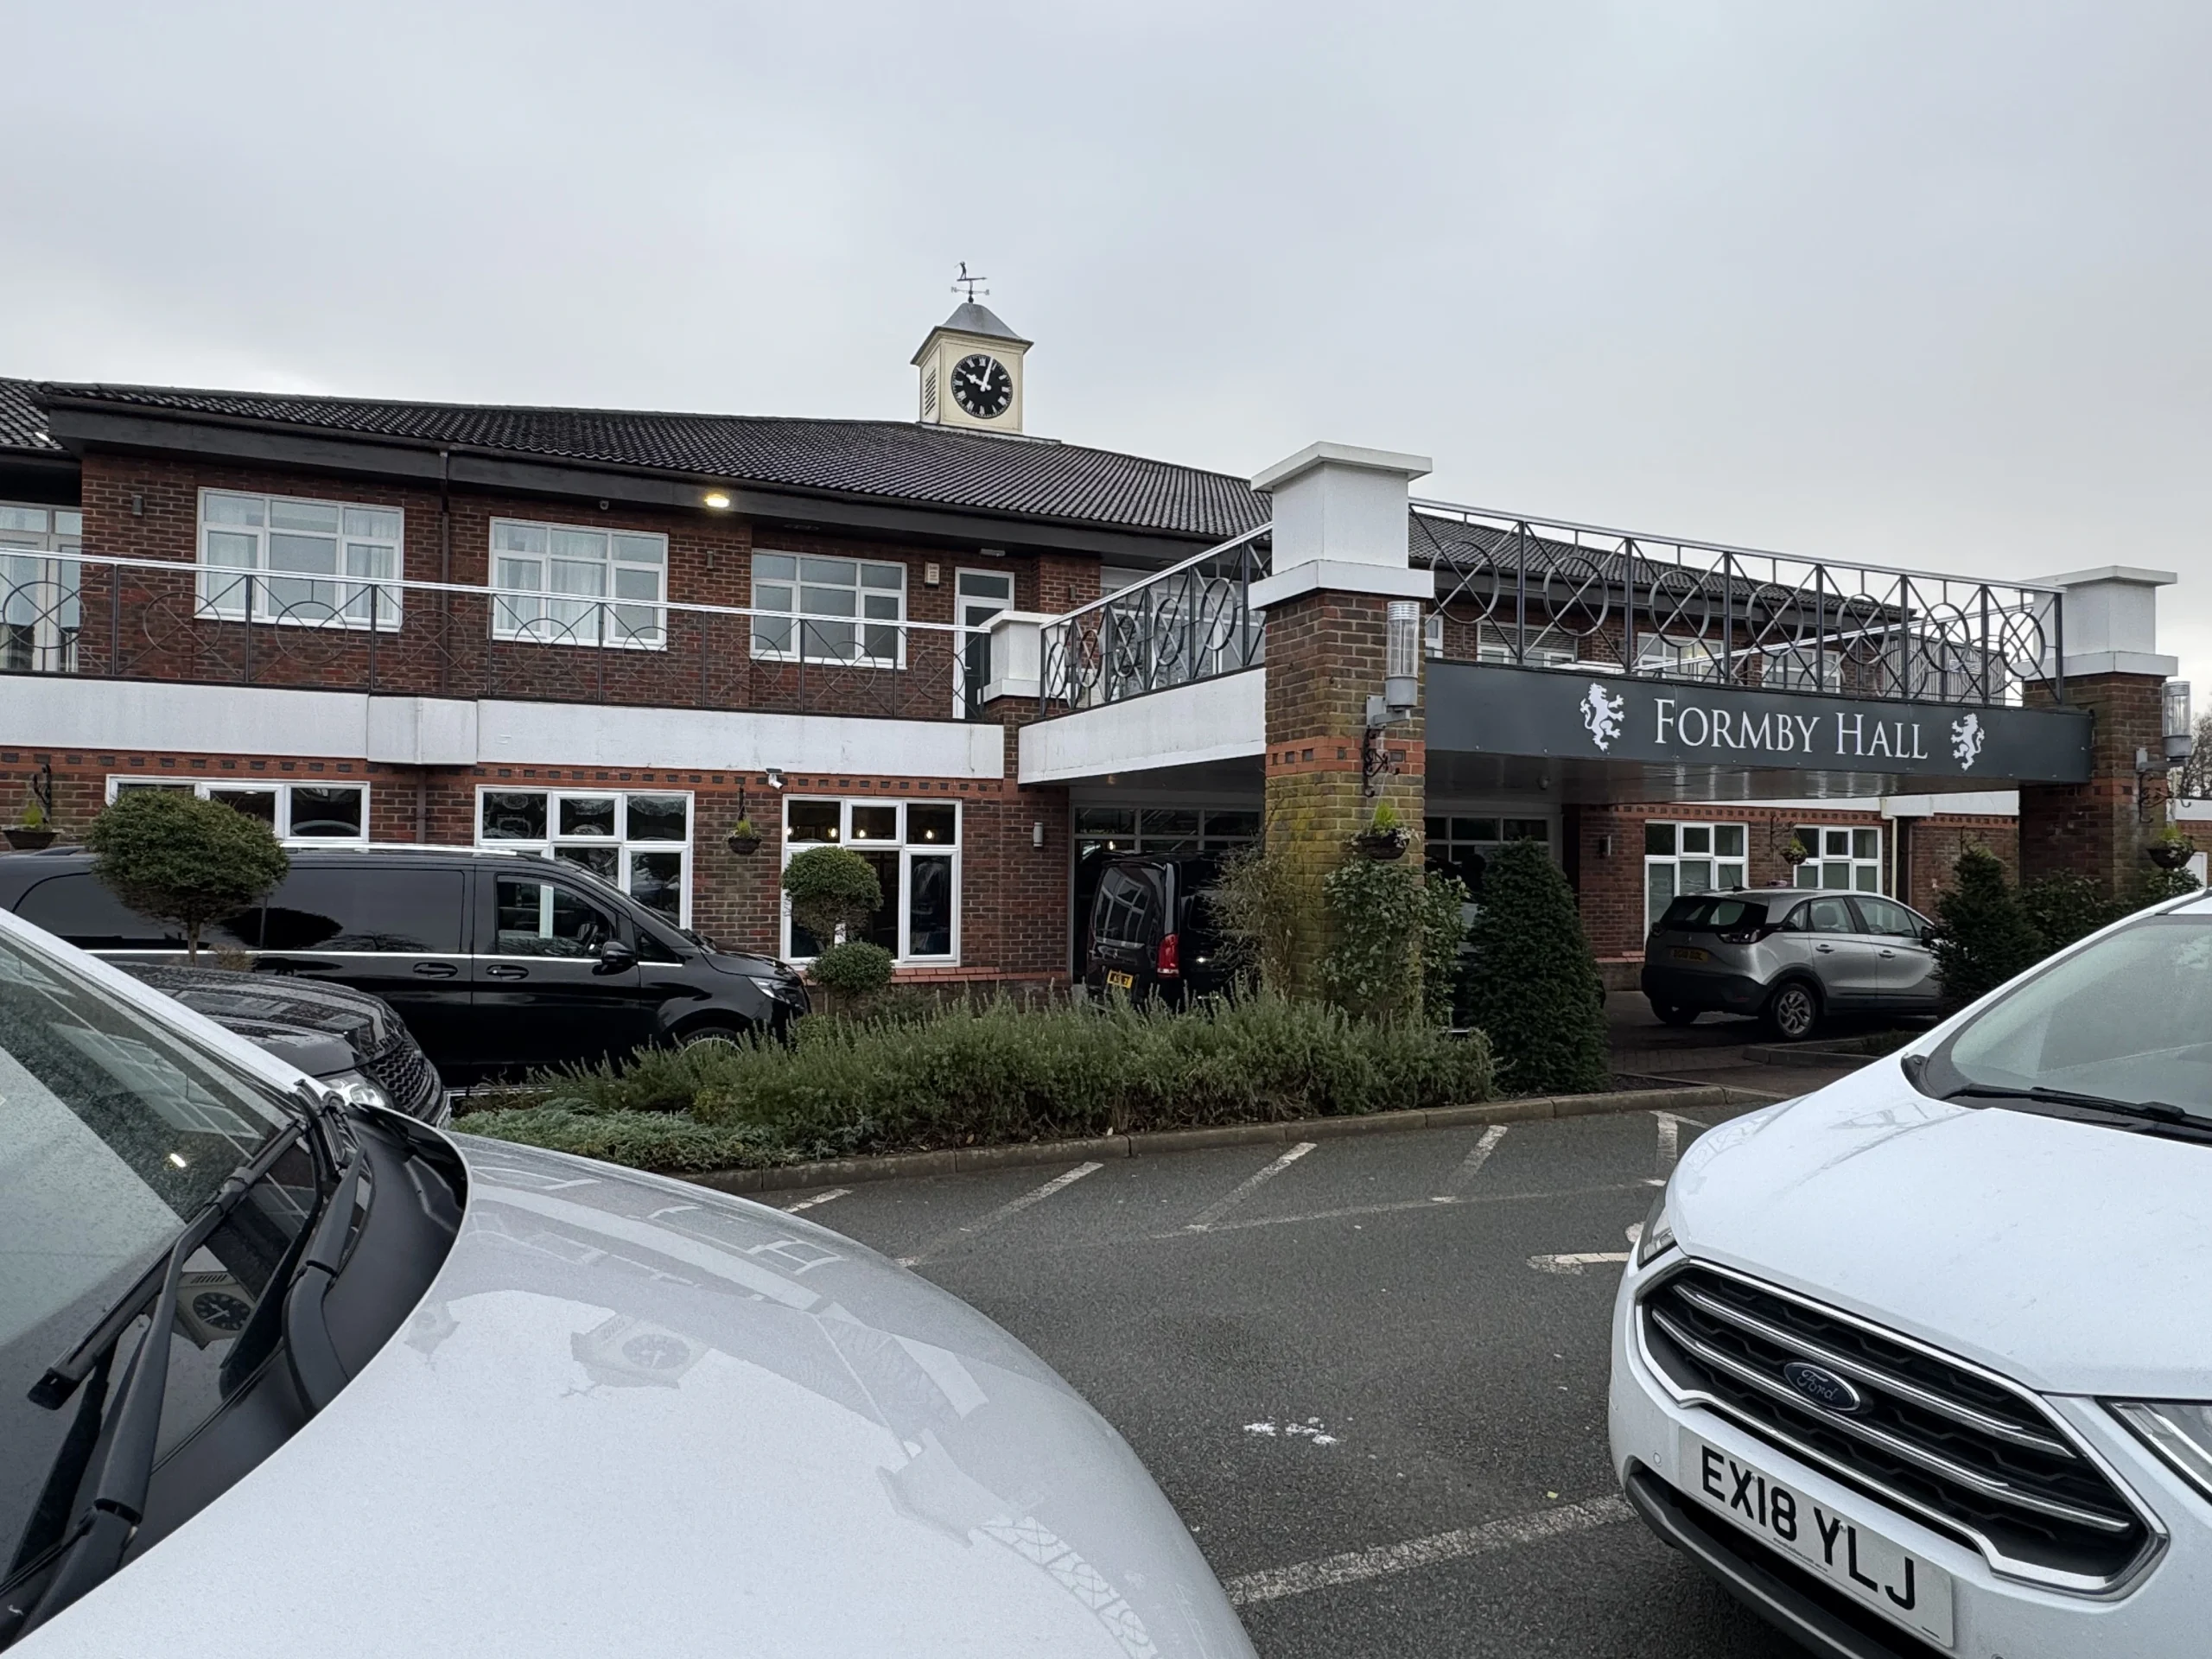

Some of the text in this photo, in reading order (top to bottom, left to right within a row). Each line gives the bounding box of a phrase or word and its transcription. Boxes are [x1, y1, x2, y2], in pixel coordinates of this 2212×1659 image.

[1654, 698, 1928, 760] FORMBY HALL
[1796, 1369, 1839, 1400] Ford
[1701, 1444, 1916, 1611] EX18 YLJ
